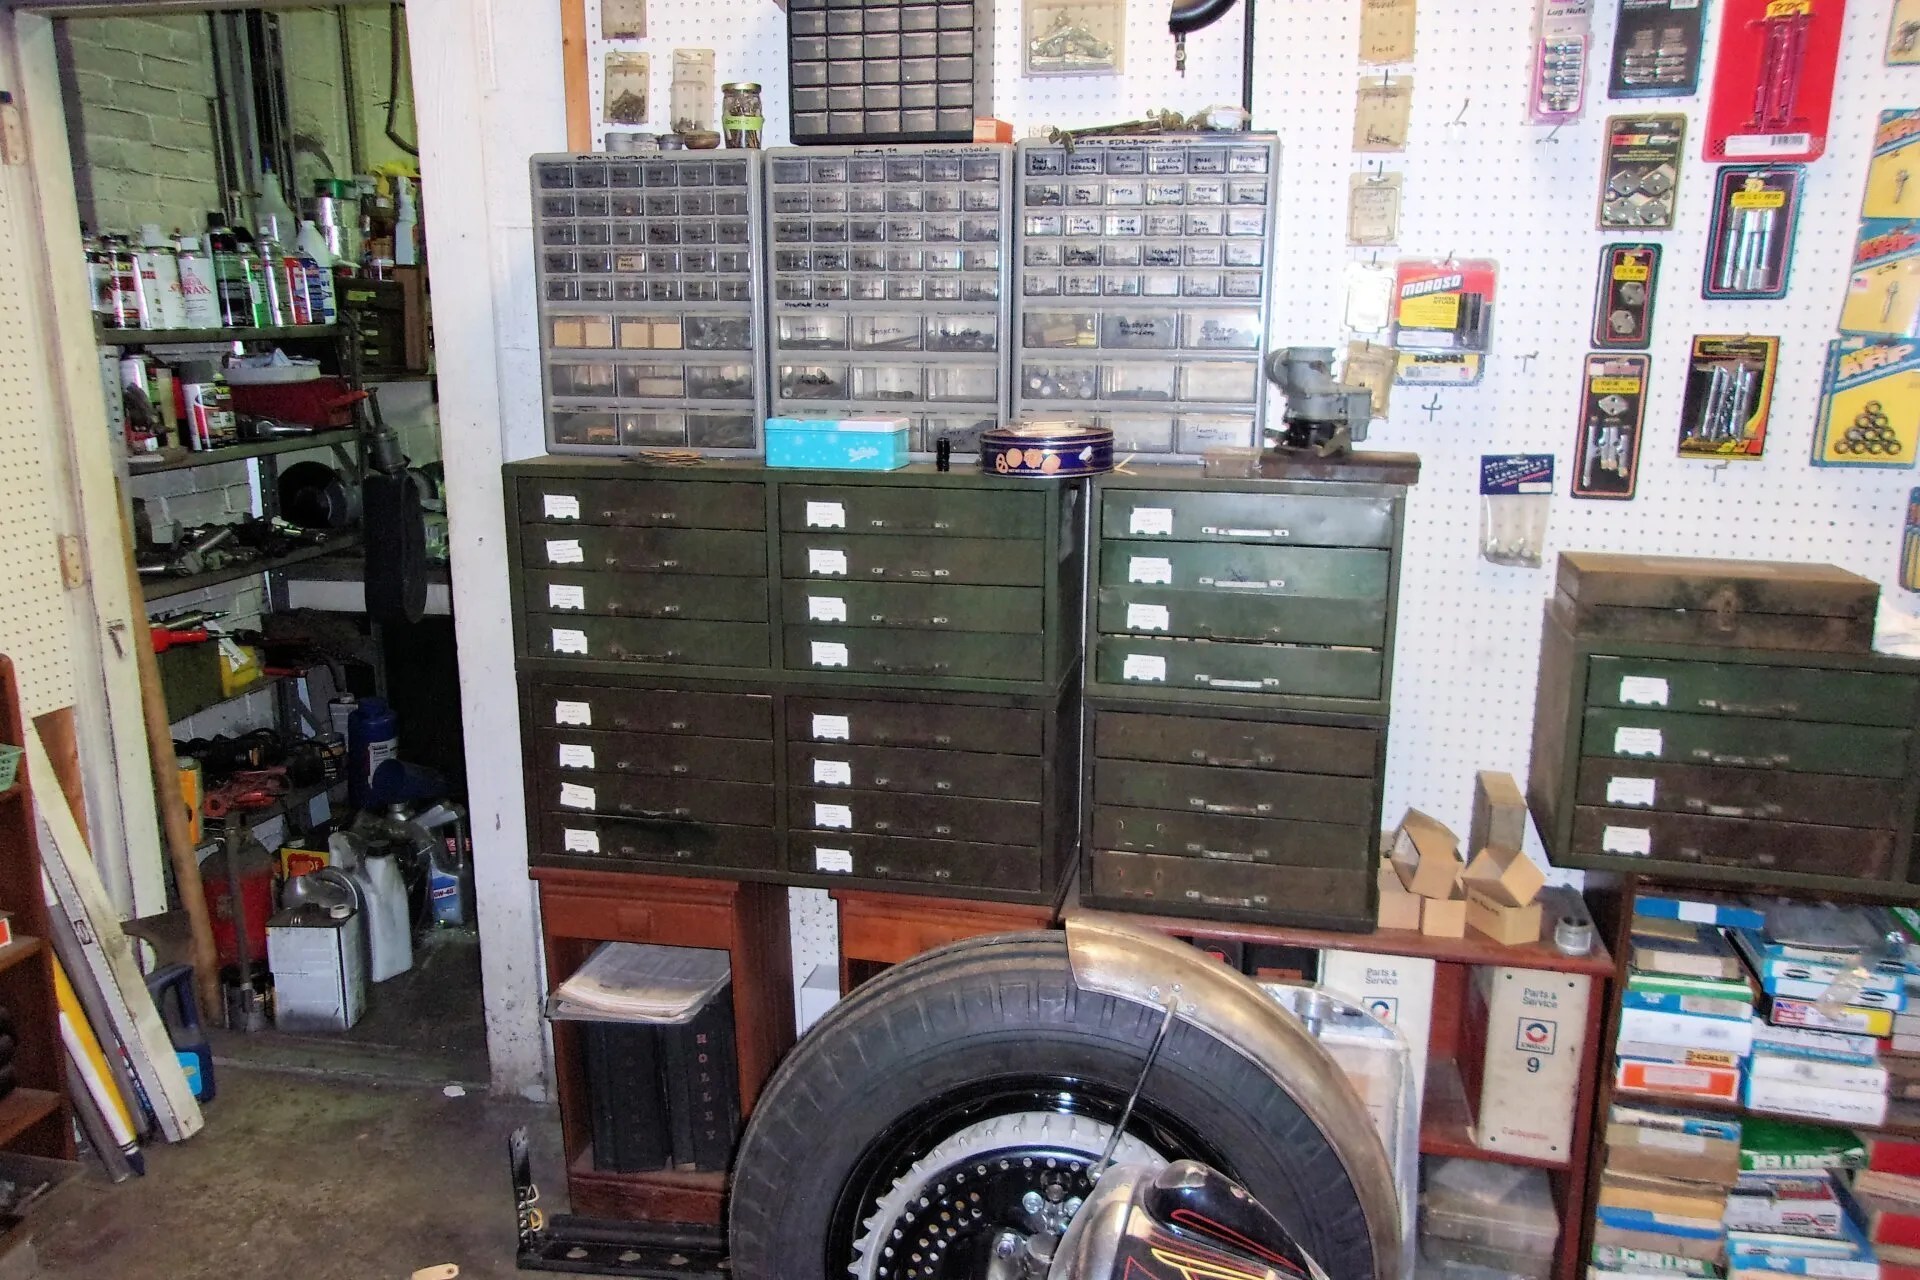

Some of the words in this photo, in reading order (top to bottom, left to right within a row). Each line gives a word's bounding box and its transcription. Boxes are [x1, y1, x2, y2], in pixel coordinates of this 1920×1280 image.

[1547, 8, 1563, 16] Lug
[1401, 275, 1461, 297] MOROSO
[1367, 968, 1389, 977] Parts
[1365, 977, 1398, 985] Service
[1524, 988, 1549, 1000] Parts
[1522, 997, 1558, 1009] Service
[1527, 1056, 1540, 1073] 9
